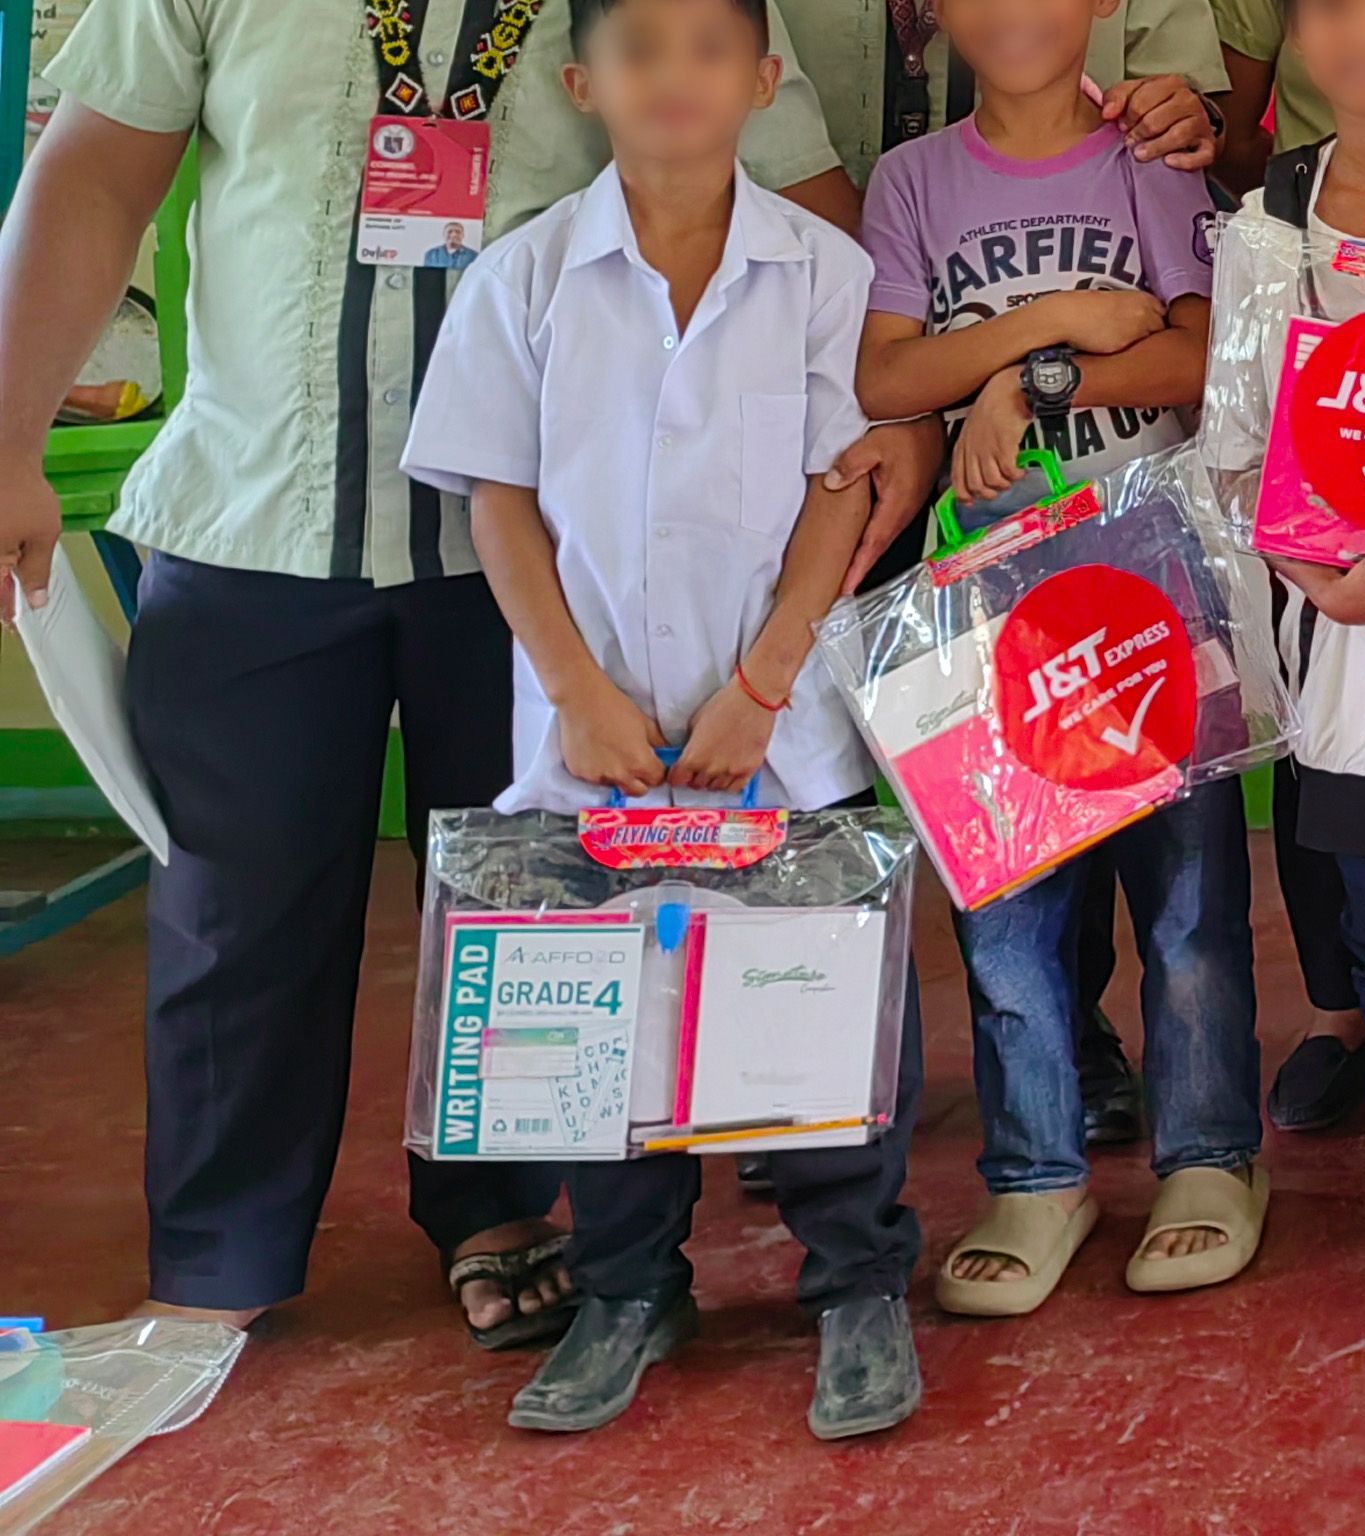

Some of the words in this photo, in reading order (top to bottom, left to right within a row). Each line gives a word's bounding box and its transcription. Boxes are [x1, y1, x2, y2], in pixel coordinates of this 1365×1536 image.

[959, 219, 1017, 245] ATHLETIC
[1020, 214, 1111, 228] DEPARTMENT
[929, 227, 1148, 323] GARFIEL
[1340, 427, 1361, 441] WE
[1024, 626, 1107, 723] J&T
[1104, 620, 1170, 667] EXPRESS
[1082, 688, 1117, 715] CARE
[1116, 672, 1143, 693] FOR
[1143, 659, 1167, 676] YOU
[611, 826, 669, 846] FLYING
[673, 825, 721, 845] EAGLE
[458, 943, 490, 1006] PAD
[497, 980, 593, 1006] GRADE
[593, 979, 622, 1015] 4
[444, 1015, 484, 1146] WRITING
